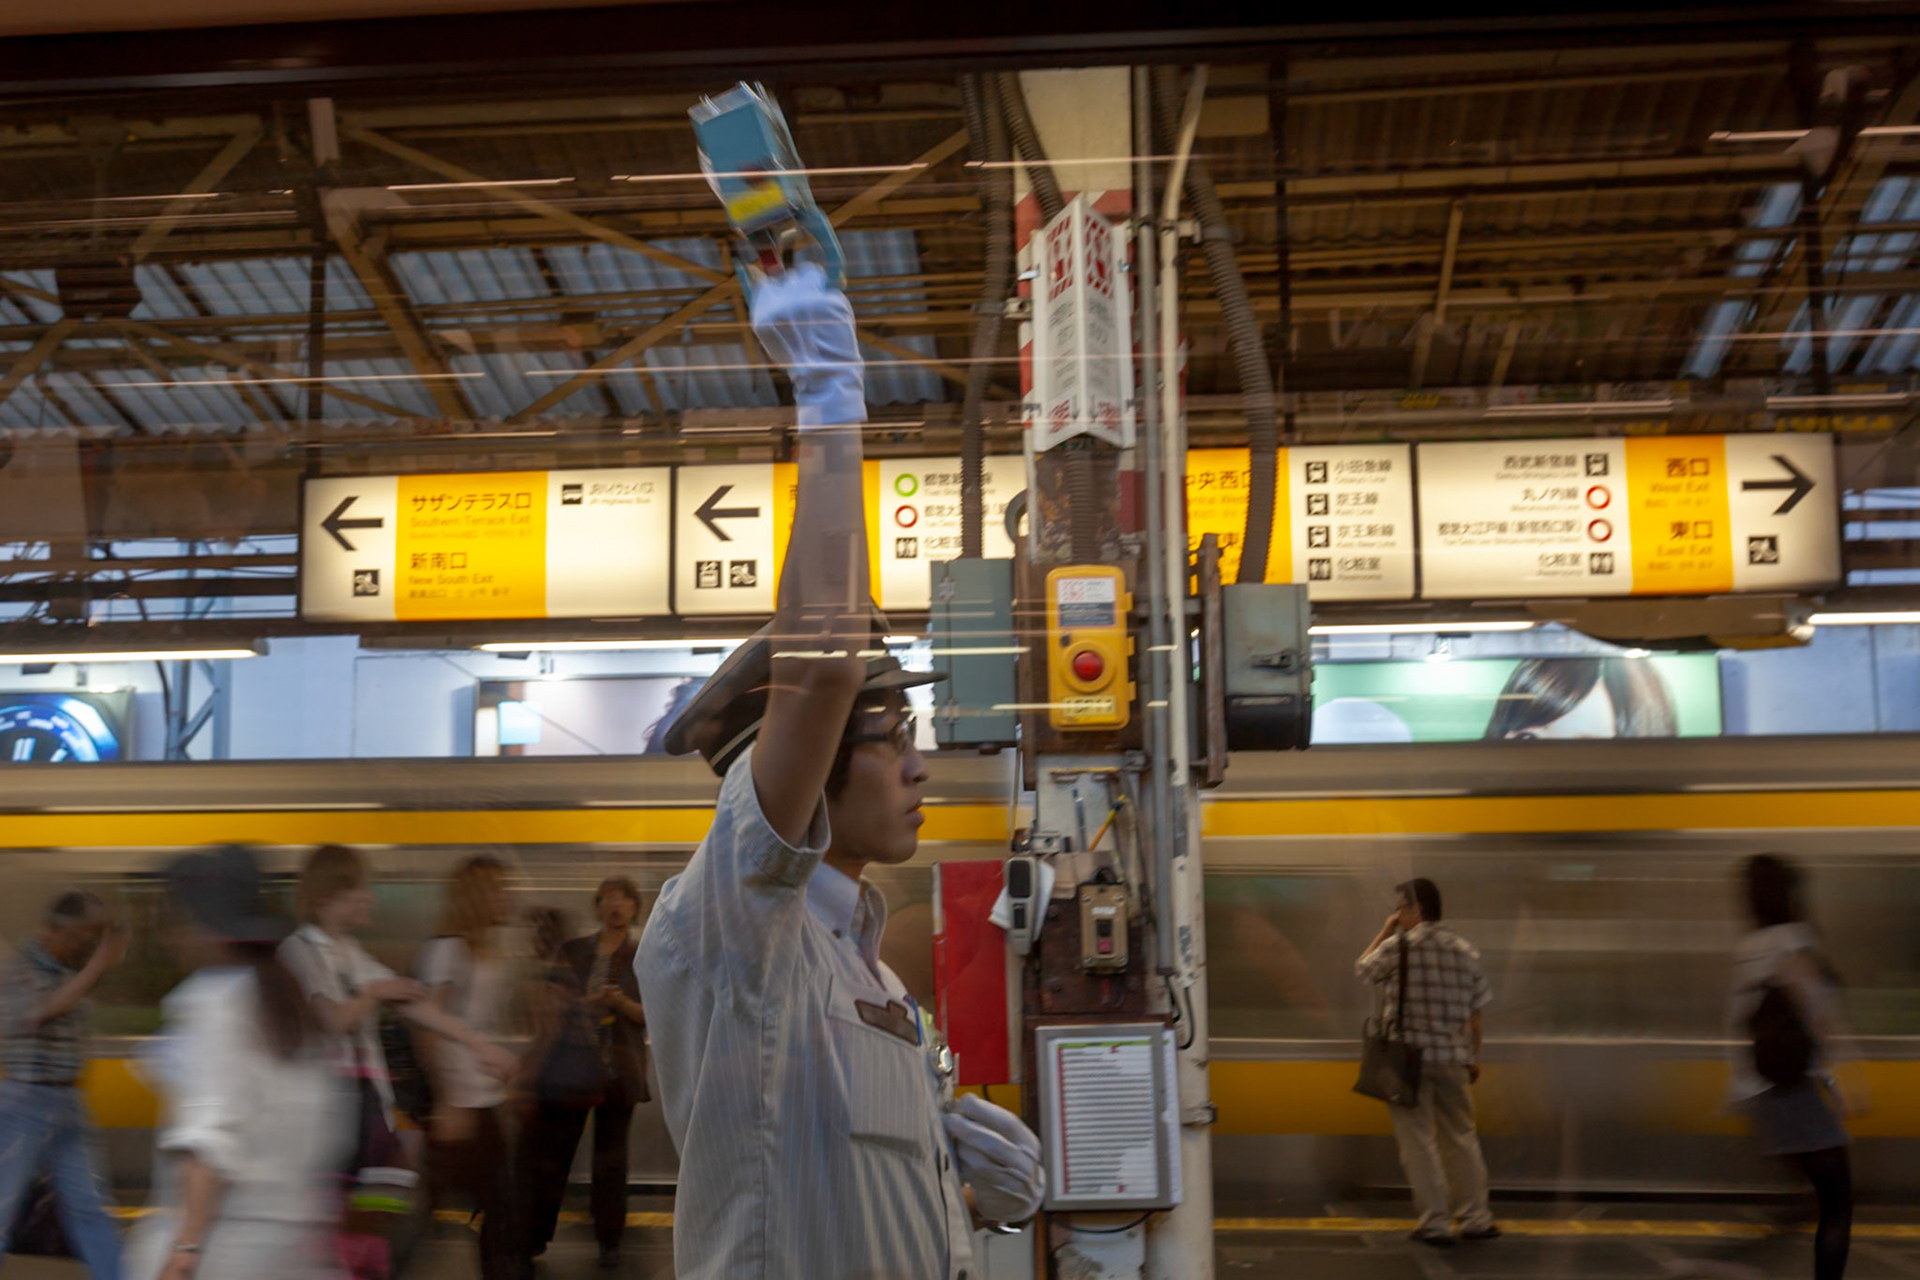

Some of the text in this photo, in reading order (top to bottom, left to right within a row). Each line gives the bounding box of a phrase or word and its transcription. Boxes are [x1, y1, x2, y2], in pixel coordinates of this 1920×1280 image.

[1335, 458, 1393, 473] 小田急線
[1503, 454, 1578, 469] 西武新宿線
[1666, 458, 1710, 477] 西口
[411, 492, 532, 512] サザンテラス口
[1336, 491, 1378, 506] 京王線
[1522, 487, 1579, 502] 丸ノ内線
[1337, 523, 1395, 538] 京王新線
[1670, 520, 1713, 540] 東口
[410, 551, 467, 570] 新南口
[1338, 555, 1381, 571] 化粧室
[1538, 553, 1582, 567] 化粧室
